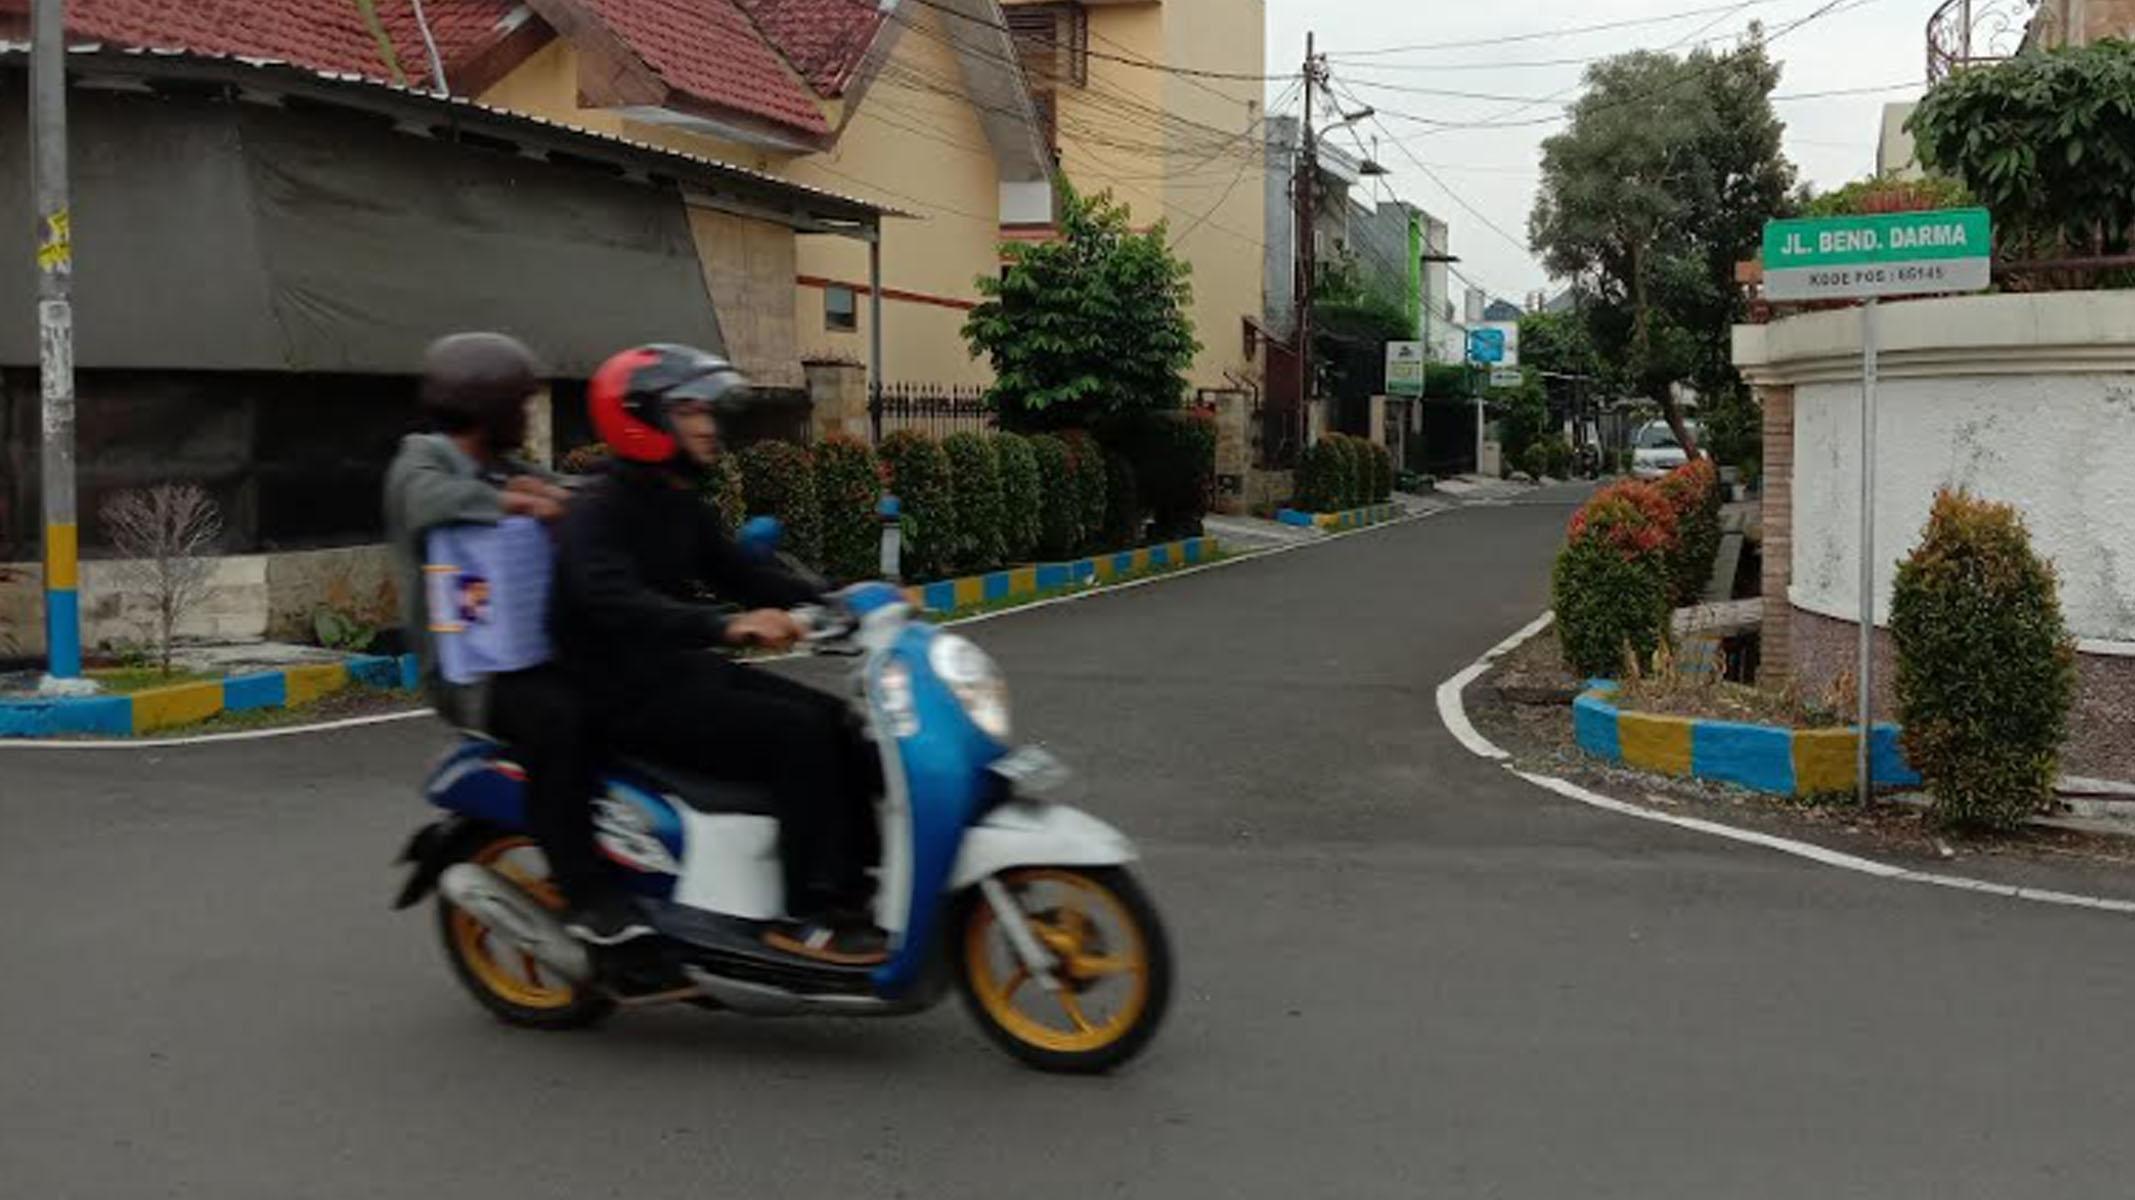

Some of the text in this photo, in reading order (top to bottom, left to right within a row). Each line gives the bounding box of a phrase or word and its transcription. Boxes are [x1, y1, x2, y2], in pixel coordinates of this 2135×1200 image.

[1781, 223, 1967, 254] JL. BEND. DARMA
[1809, 272, 1850, 286] KODE
[1855, 269, 1885, 282] POS
